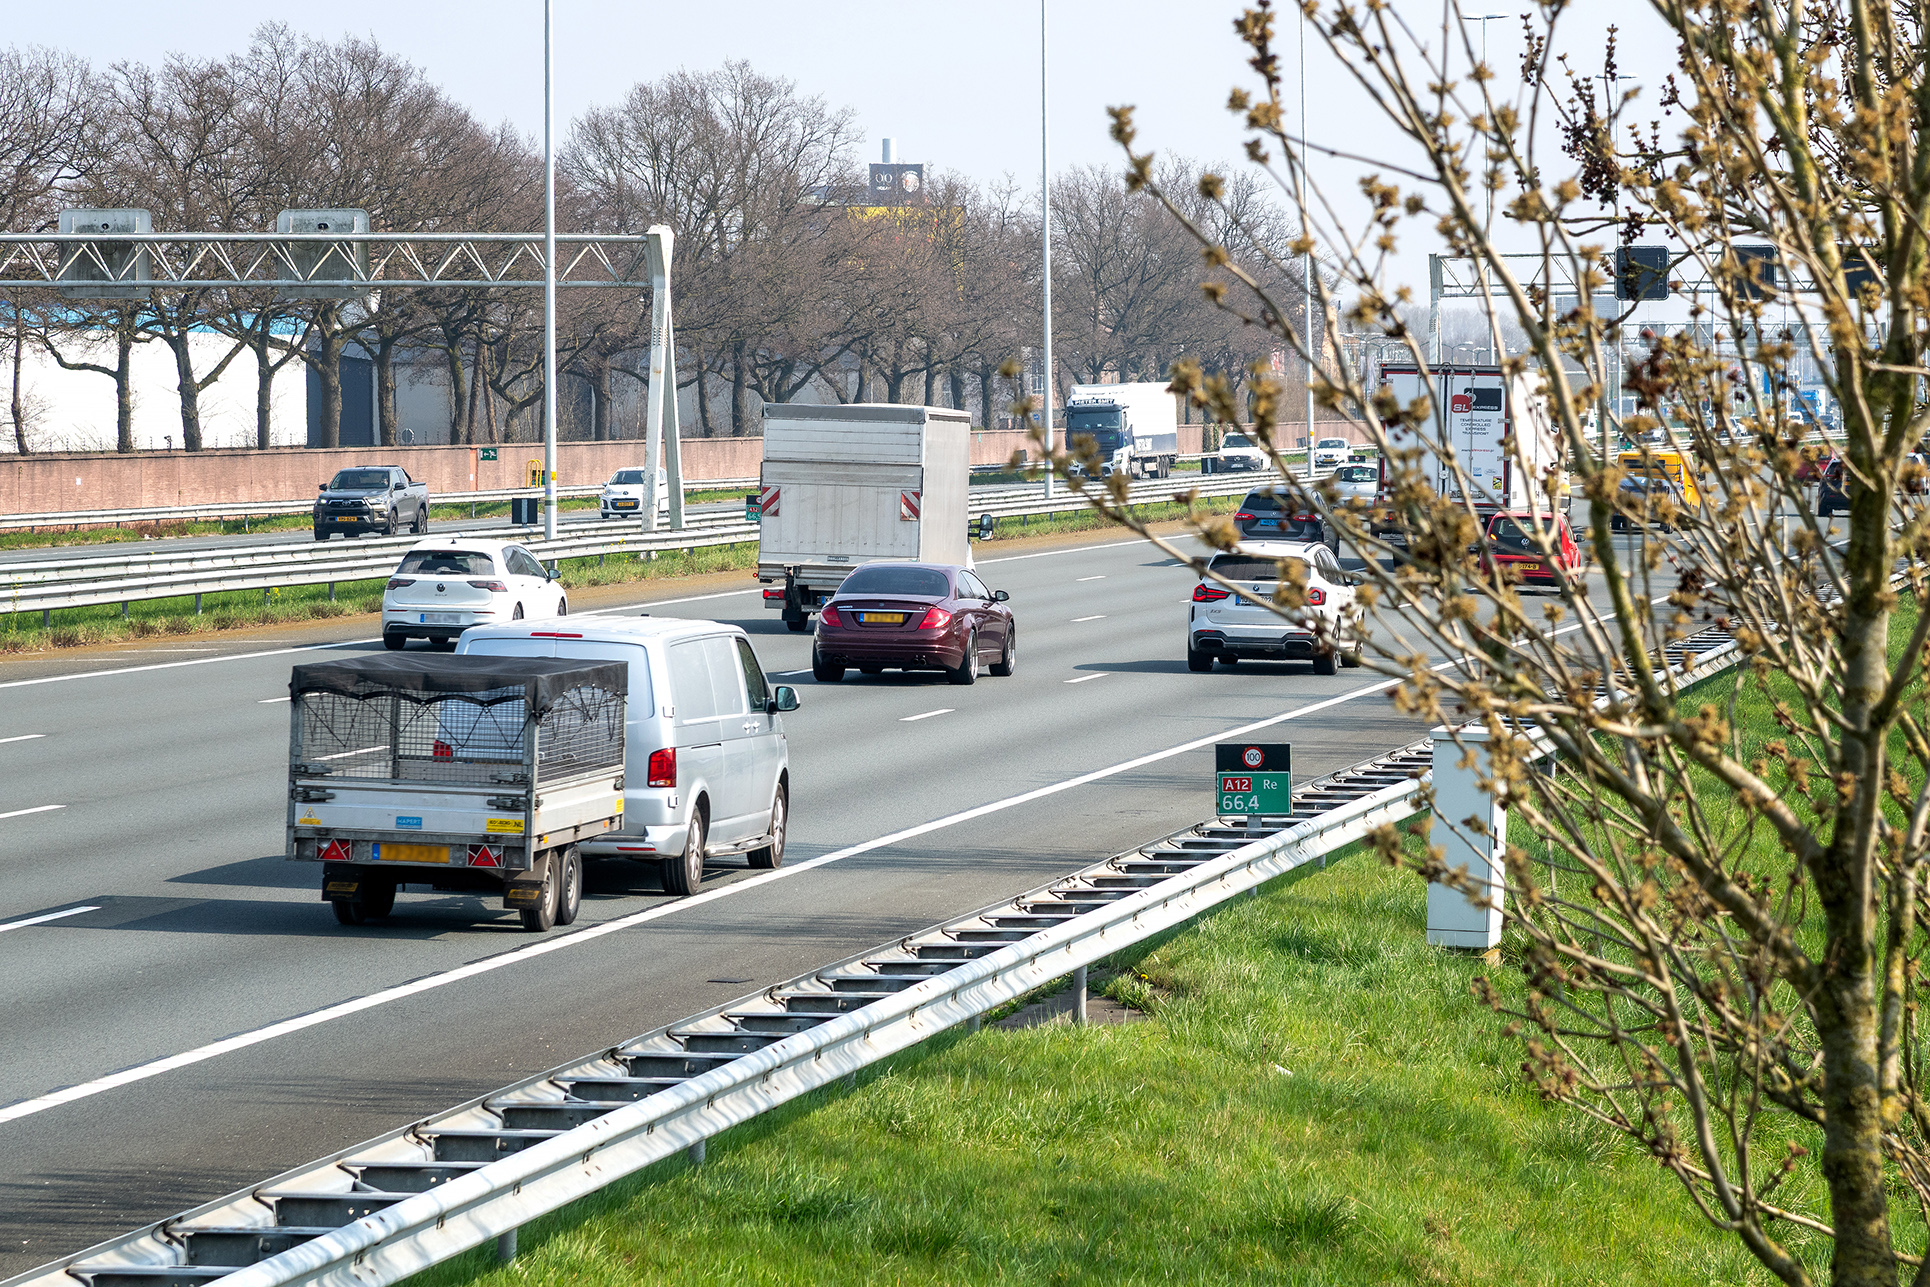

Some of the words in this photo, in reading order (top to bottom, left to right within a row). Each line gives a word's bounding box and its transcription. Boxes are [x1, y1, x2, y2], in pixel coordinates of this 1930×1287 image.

[1453, 404, 1469, 412] SL
[1246, 753, 1261, 762] 100
[1225, 779, 1249, 790] A12
[1263, 779, 1278, 790] Re
[1222, 795, 1260, 812] 66,4
